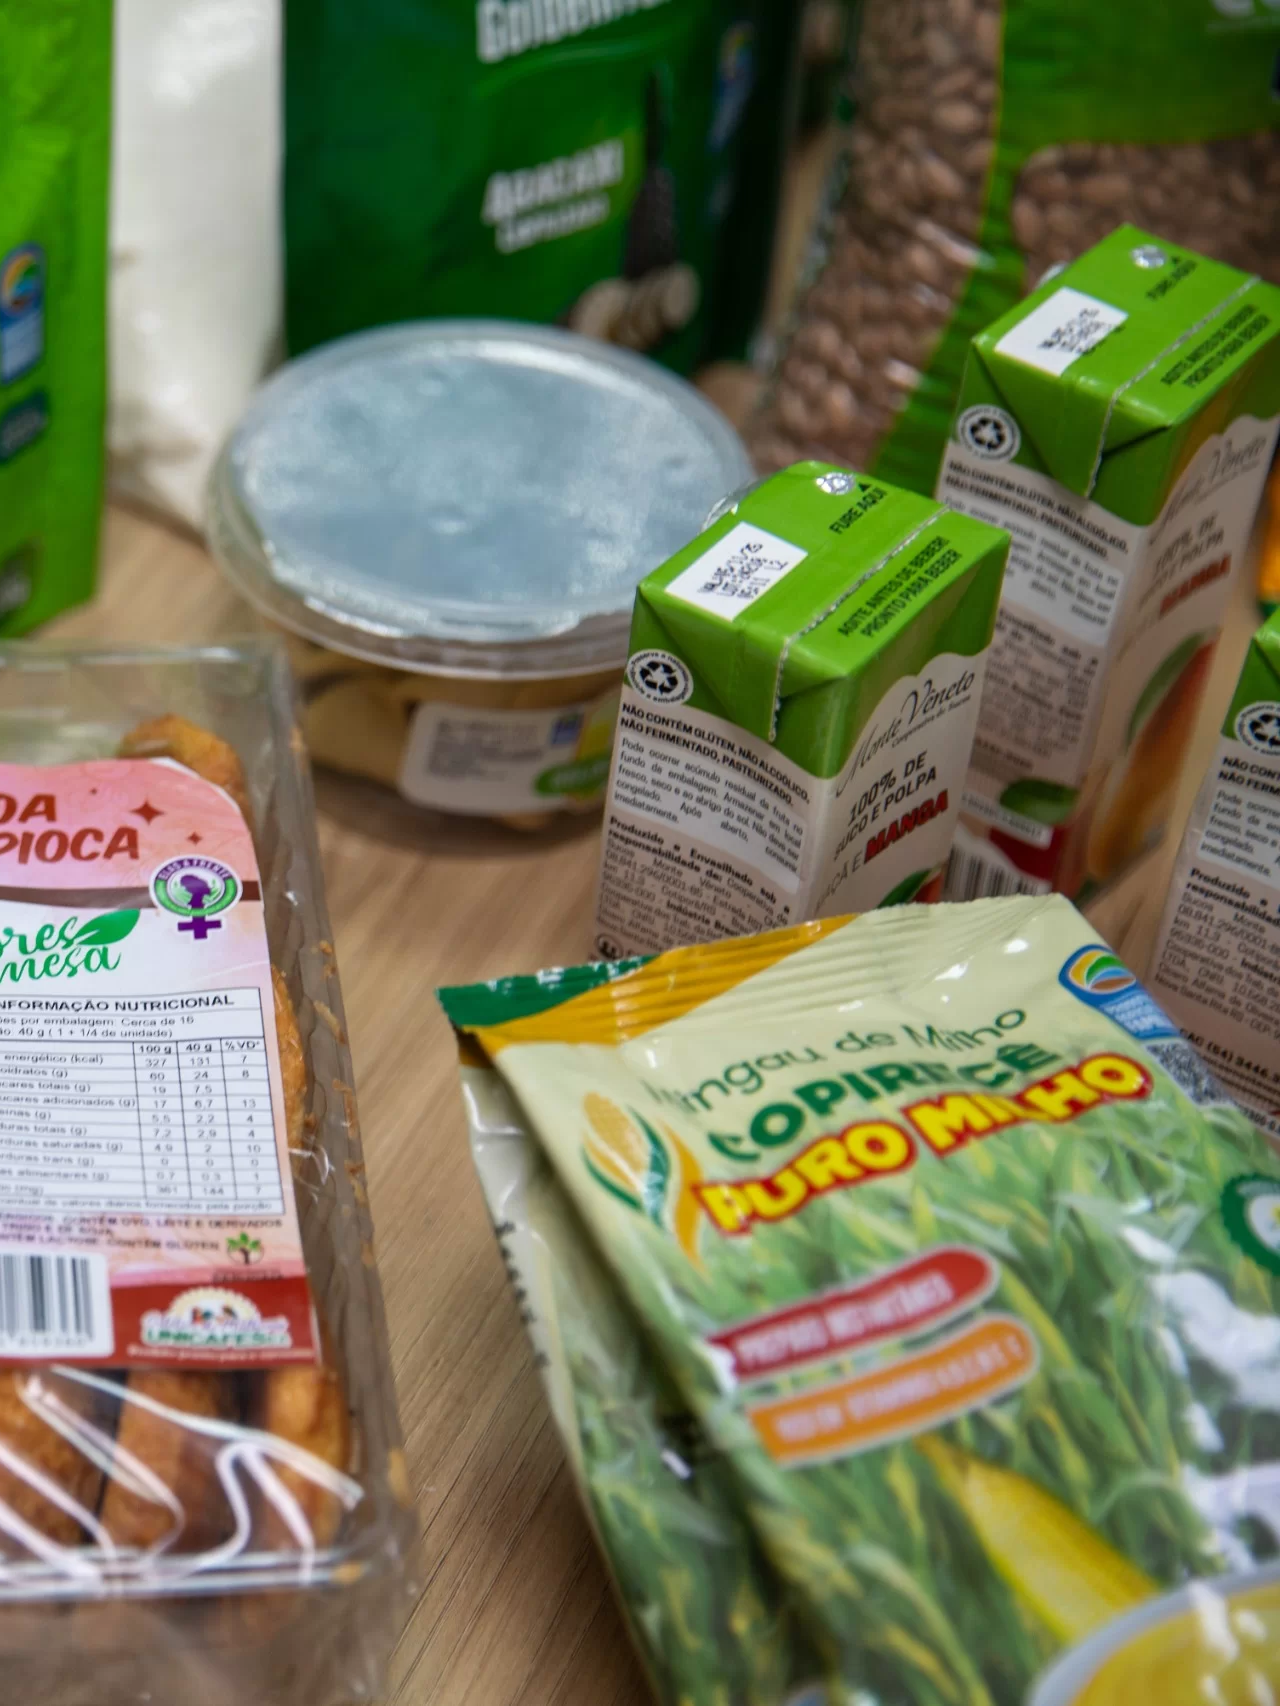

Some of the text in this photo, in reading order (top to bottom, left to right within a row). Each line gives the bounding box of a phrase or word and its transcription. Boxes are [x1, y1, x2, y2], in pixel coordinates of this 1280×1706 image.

[829, 487, 888, 535] FURE AQUI
[837, 579, 904, 637] AGITE ANTES
[860, 576, 932, 638] PRONTO PARA
[620, 717, 644, 734] NÃO
[645, 726, 721, 764] FERMENTADO,
[622, 702, 645, 720] NÃO
[646, 711, 693, 735] CONTÉM
[738, 746, 759, 765] NÃO
[622, 738, 791, 827] Pode ocorrer acúmulo residual fruta
[1218, 770, 1245, 786] NÃO
[1222, 755, 1249, 772] NÃO
[618, 764, 648, 785] fresco,
[651, 777, 673, 793] seco
[695, 795, 722, 813] abrigo
[751, 821, 768, 838] Não
[620, 751, 646, 769] fundo
[723, 791, 765, 821] Armazenar
[784, 829, 802, 849] local
[847, 750, 928, 827] 100% DE
[1217, 789, 1242, 805] Pode
[680, 801, 702, 819] Após
[720, 820, 749, 844] aberto,
[833, 814, 869, 861] SUCO
[870, 802, 882, 824] E
[883, 766, 937, 813] POLPA
[863, 787, 949, 865] MANGA
[1213, 802, 1242, 820] fundo
[608, 829, 701, 873] responsabilidade
[610, 815, 777, 905] Produzido Envasilhado sob
[1190, 867, 1251, 899] Produzido
[20, 1016, 40, 1027] por
[121, 1017, 157, 1027] Cerca
[160, 1017, 176, 1026] de
[114, 994, 235, 1012] NUTRICIONAL
[18, 1026, 173, 1039] 40 de unidade)
[138, 1043, 201, 1054] 100 40
[834, 1031, 898, 1054] de
[900, 1007, 1028, 1052] Milho
[4, 1053, 68, 1065] energético
[70, 1053, 104, 1066] (kcal)
[145, 1057, 167, 1068] 327
[190, 1056, 211, 1067] 131
[51, 1067, 69, 1079] (g)
[193, 1070, 209, 1080] 24
[38, 1080, 71, 1091] totais
[42, 1095, 115, 1107] adicionados
[694, 1120, 914, 1235] PURO
[902, 1053, 1152, 1157] MILHO
